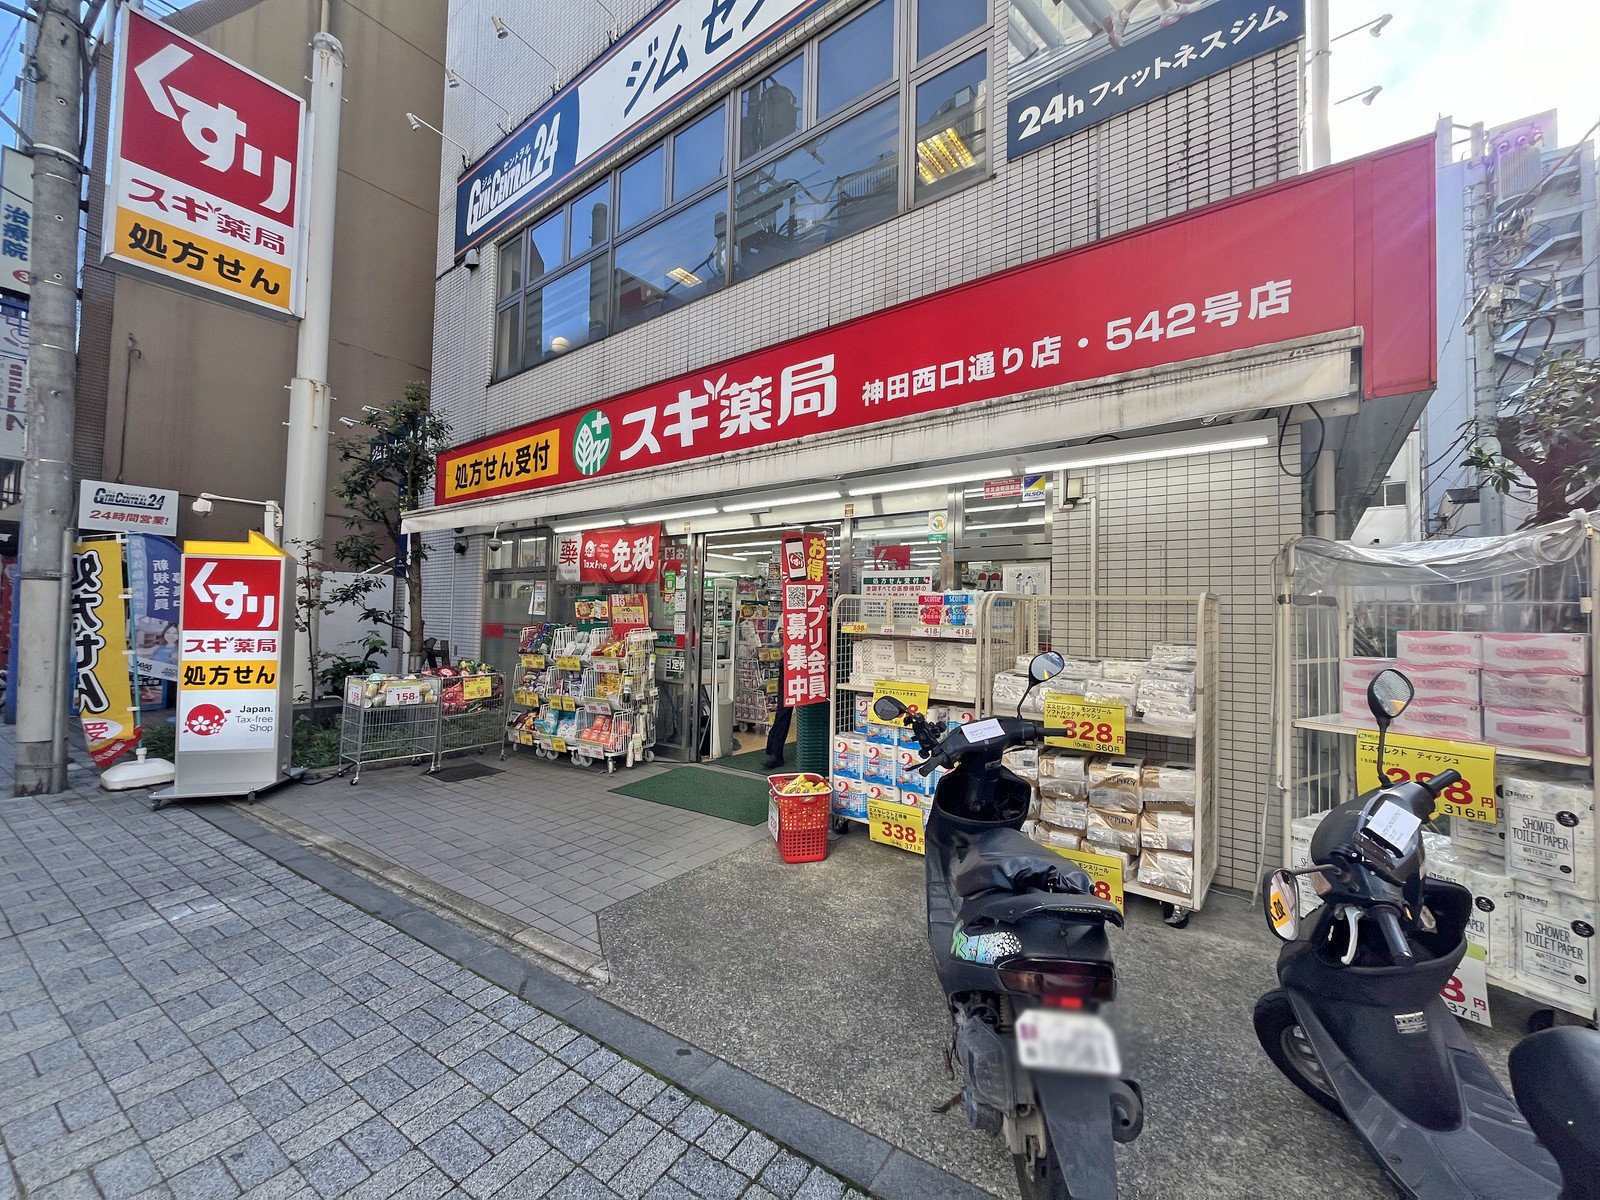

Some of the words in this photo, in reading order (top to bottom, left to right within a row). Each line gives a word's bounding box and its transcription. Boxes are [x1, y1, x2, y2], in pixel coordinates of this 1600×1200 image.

[1018, 93, 1084, 141] 24h
[1089, 5, 1289, 107] フィットネスジム
[134, 43, 292, 214] くすり
[128, 178, 286, 256] スギ薬局
[3, 204, 29, 262] 治療院
[129, 223, 280, 295] 処方せん
[619, 353, 838, 462] スギ薬局
[455, 439, 551, 491] 処方せん受付
[609, 535, 655, 573] 免税
[872, 577, 920, 585] 処方せん受付
[190, 562, 275, 628] くすり
[185, 636, 277, 654] スギ薬局
[786, 612, 808, 702] 募集中
[184, 665, 275, 686] 処方せん
[396, 692, 415, 701] 158
[1046, 703, 1076, 711] エスセレクト
[1081, 706, 1113, 715] モンスリール
[1046, 709, 1102, 720] ソフトパックティッシュ
[236, 715, 273, 724] Tax-free
[249, 724, 273, 733] Shop
[838, 742, 849, 759] 2
[869, 747, 880, 765] 2
[1417, 752, 1461, 765] ティッシュ
[838, 781, 849, 799] 2
[1514, 791, 1534, 800] SELECT
[1522, 817, 1556, 836] SHOWER
[1512, 827, 1542, 845] TOILET
[1543, 833, 1569, 851] PAPER
[1522, 846, 1543, 857] WATER
[1078, 862, 1109, 874] モンスリール
[1466, 918, 1485, 935] APER
[1535, 922, 1570, 944] SHOWER
[1524, 930, 1557, 951] TOILET
[1557, 941, 1584, 961] PAPER
[1535, 952, 1557, 963] WATER
